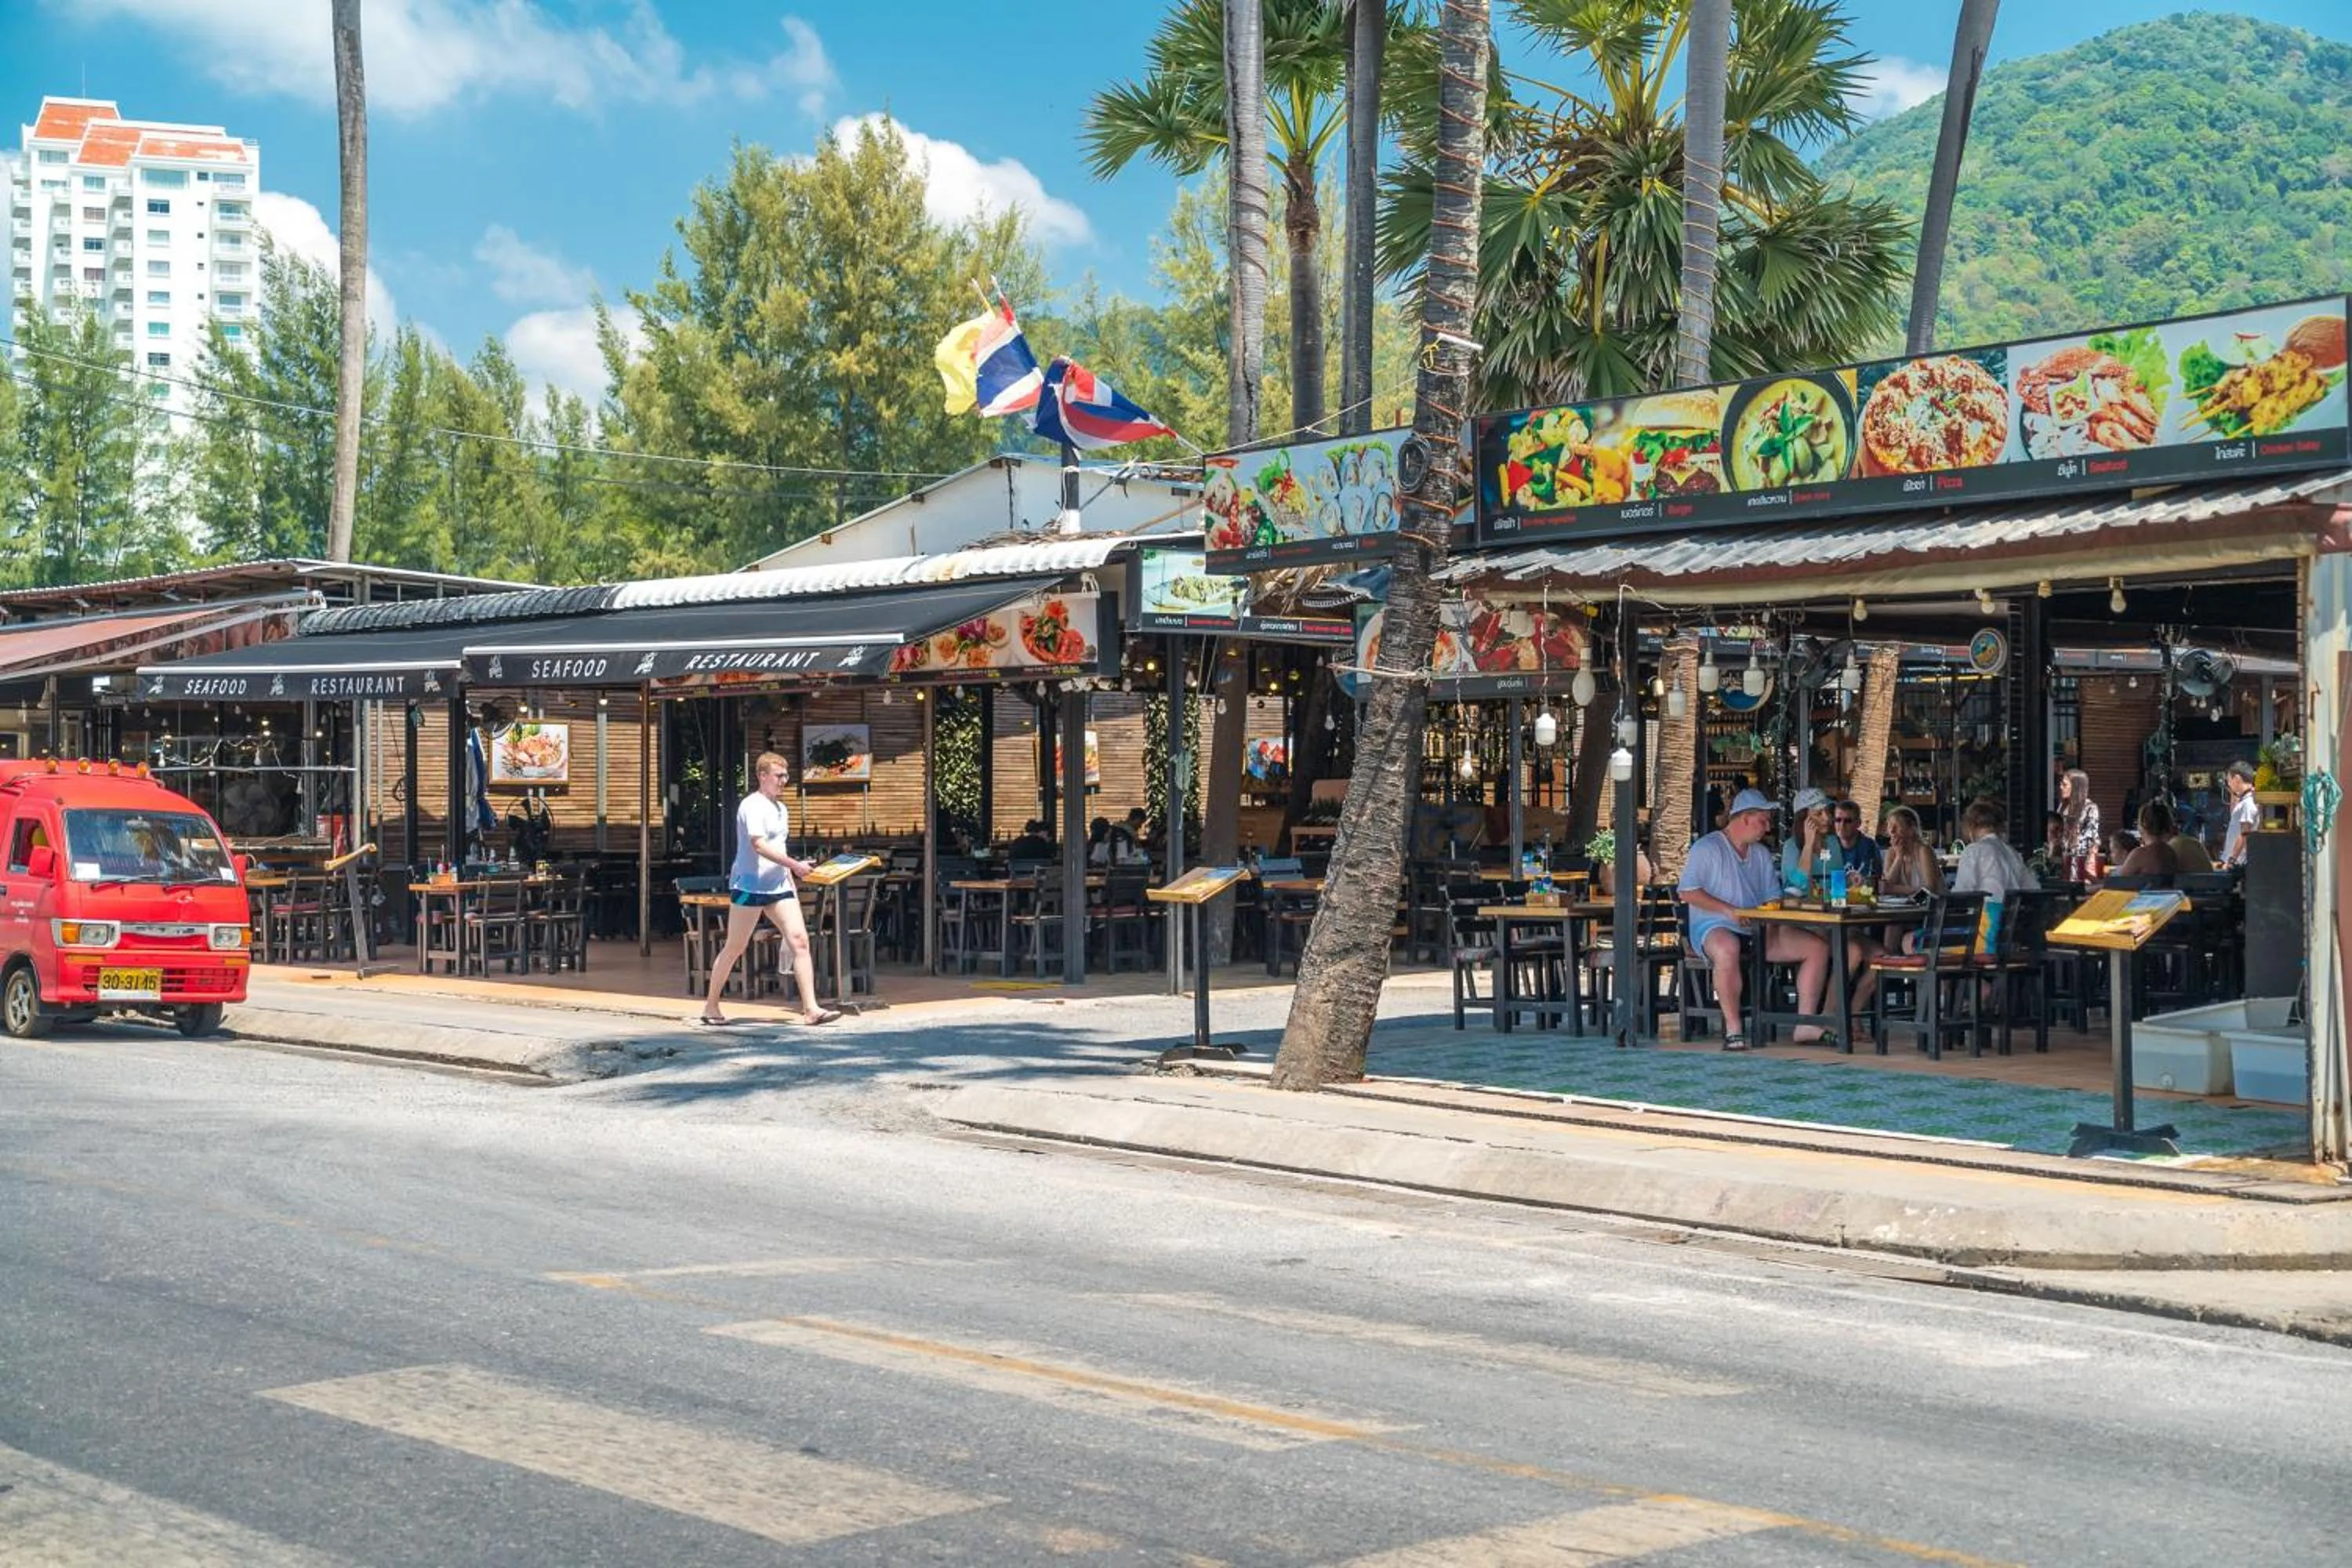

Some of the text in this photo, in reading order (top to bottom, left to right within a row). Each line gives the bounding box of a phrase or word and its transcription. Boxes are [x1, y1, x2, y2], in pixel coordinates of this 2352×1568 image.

[532, 651, 820, 679] SEAFOOD RESTAURANT
[184, 676, 406, 695] SEAFOOD RESTAURANT
